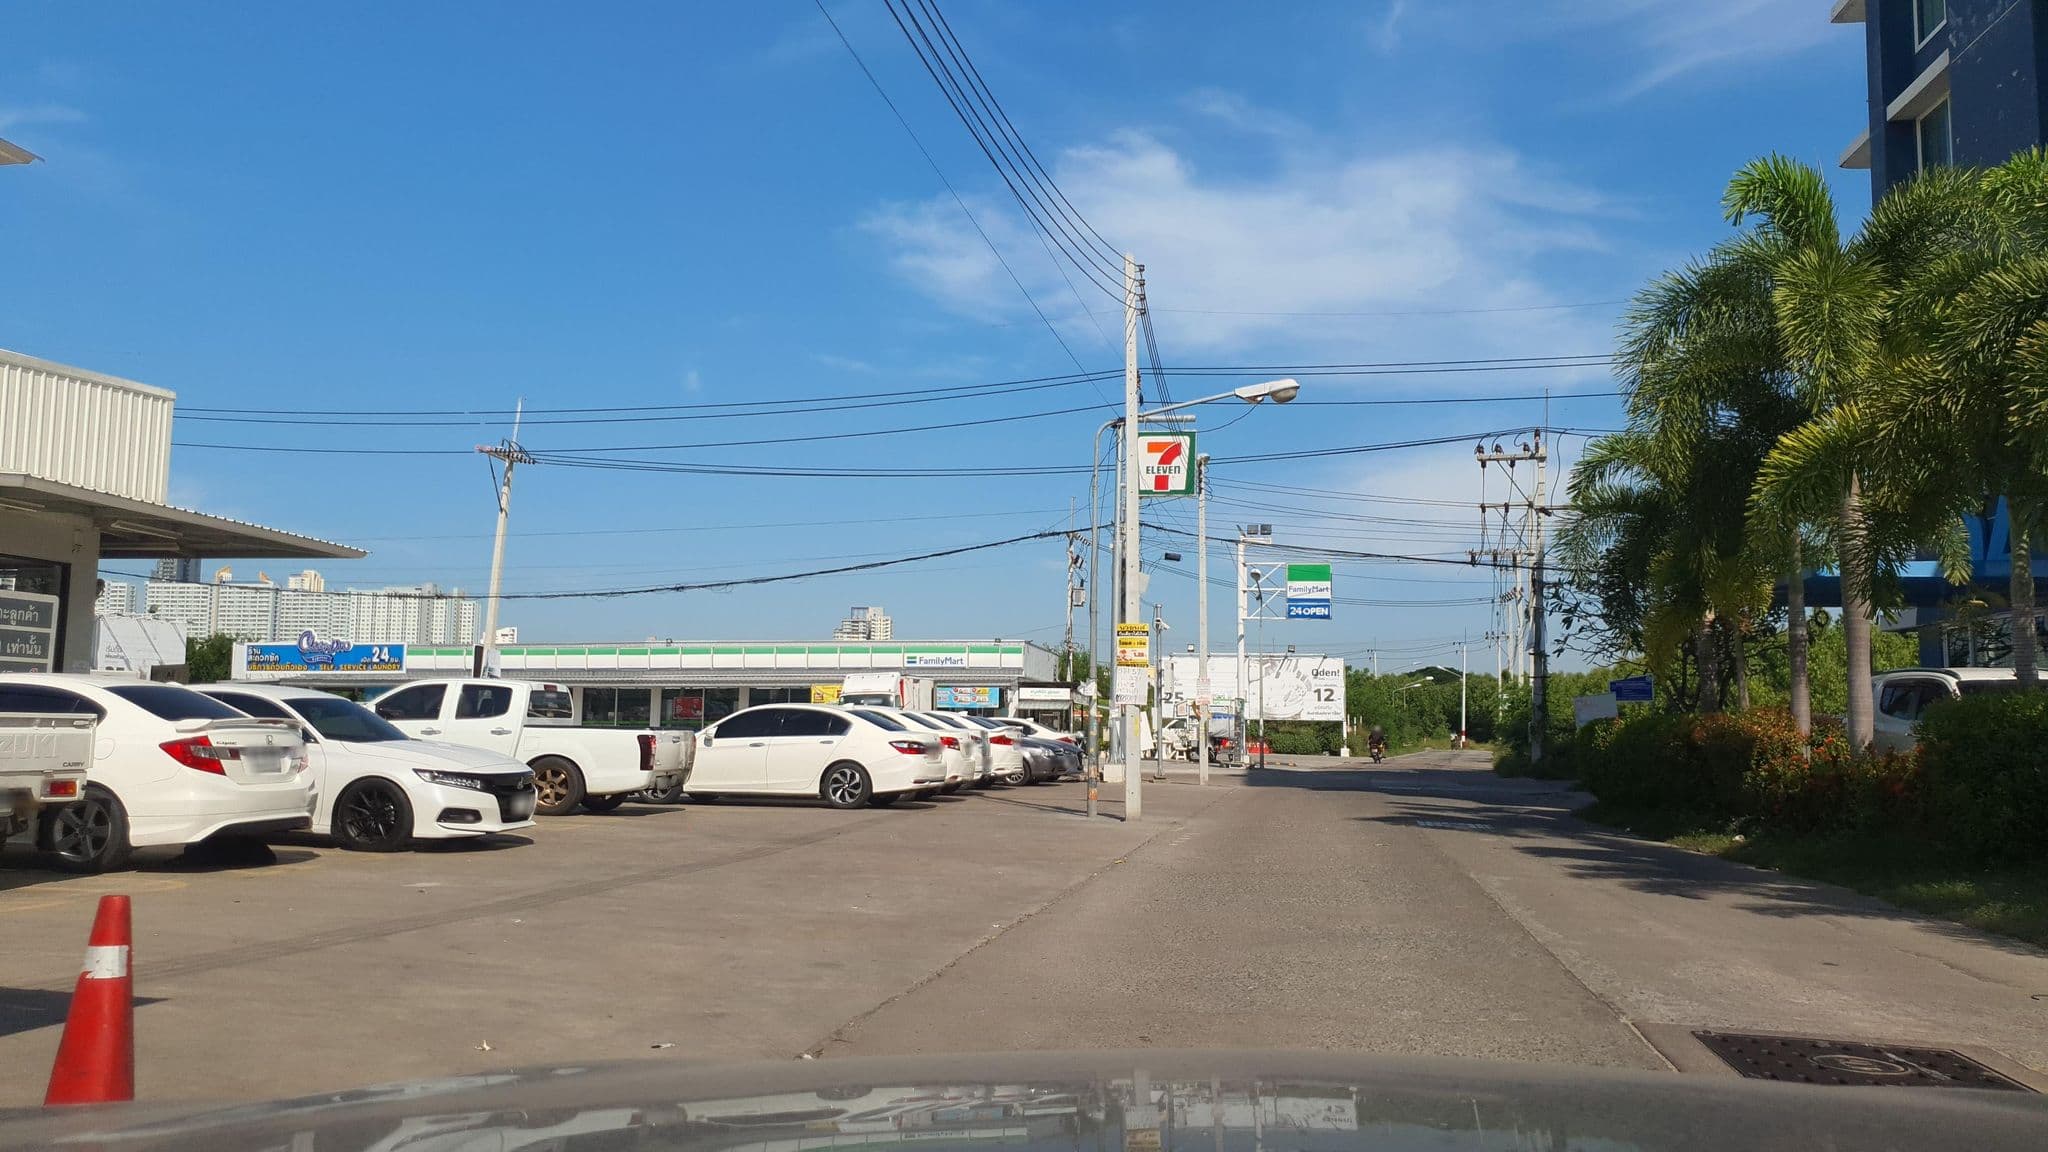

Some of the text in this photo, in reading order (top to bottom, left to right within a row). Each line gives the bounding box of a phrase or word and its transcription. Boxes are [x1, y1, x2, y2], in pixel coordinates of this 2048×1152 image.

[1147, 441, 1182, 491] 7
[1289, 585, 1329, 594] FamilyMart
[1290, 606, 1329, 616] 24 OPEN
[372, 646, 390, 662] 24
[919, 656, 964, 665] FamilyMart
